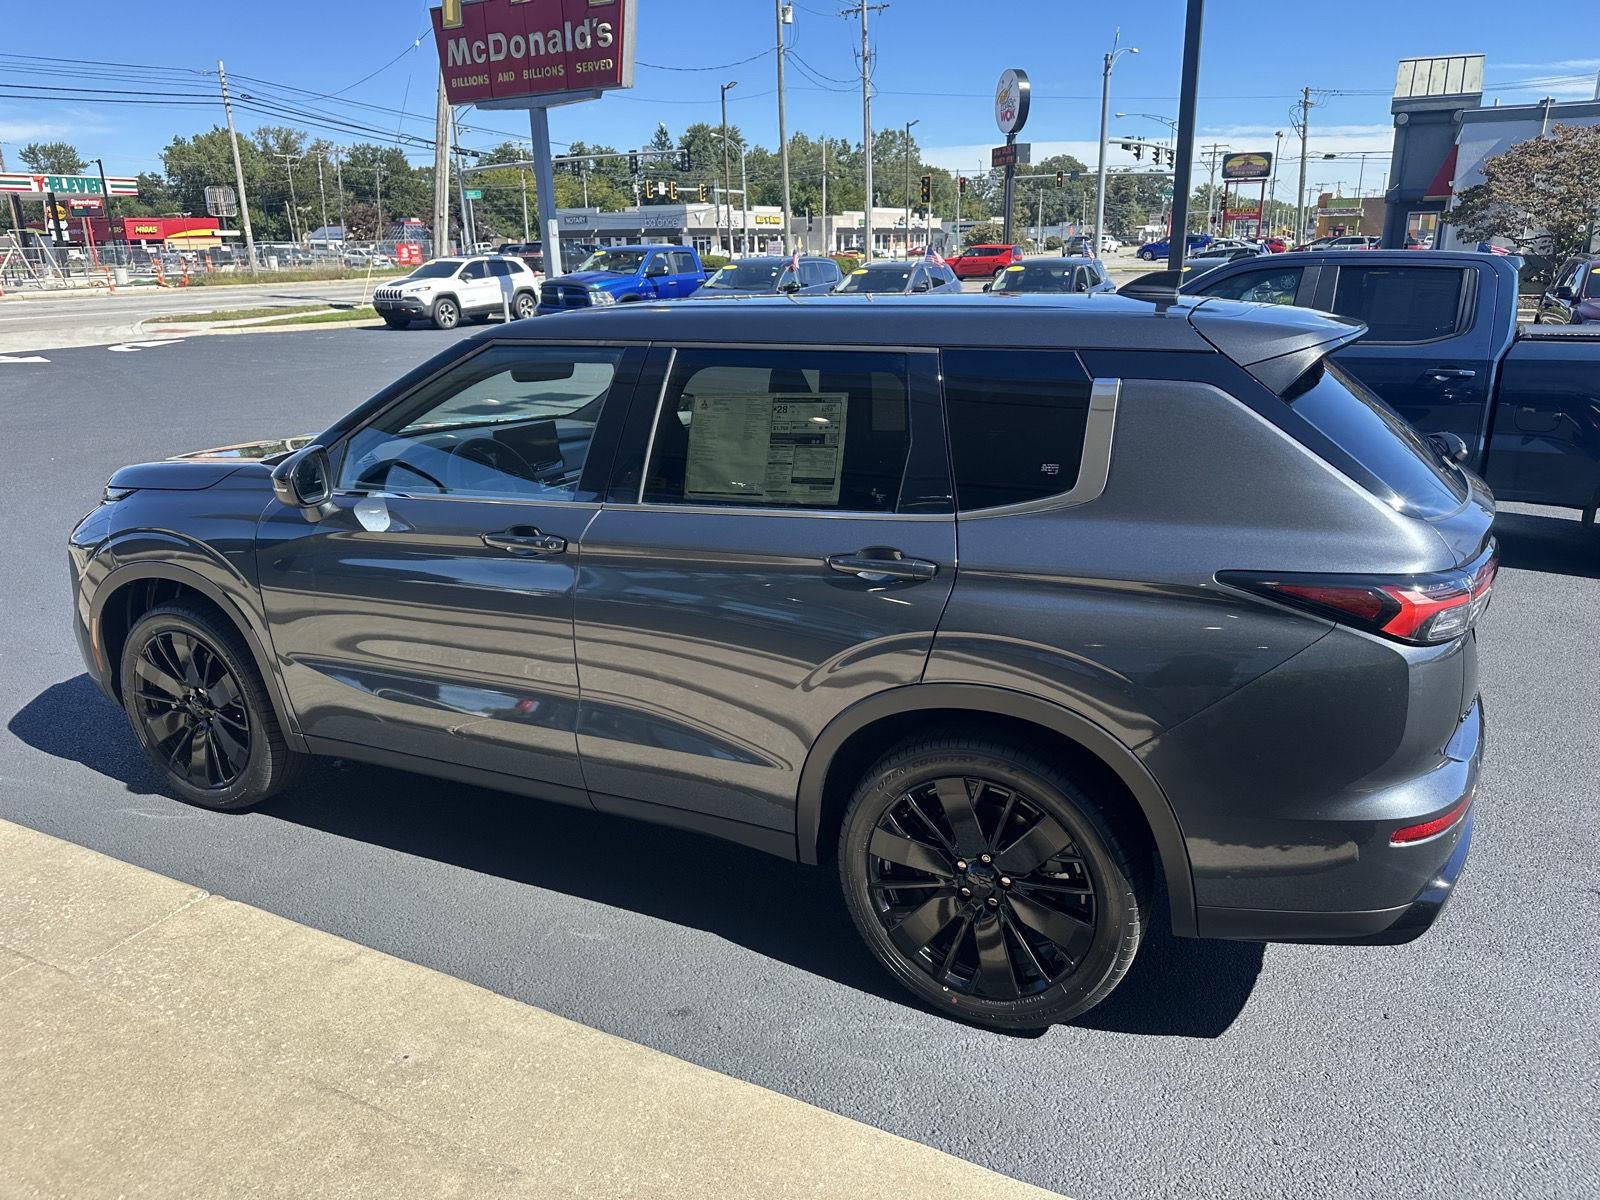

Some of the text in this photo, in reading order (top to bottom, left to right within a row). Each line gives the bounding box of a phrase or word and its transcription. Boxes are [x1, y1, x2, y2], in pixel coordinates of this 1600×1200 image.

[447, 17, 613, 67] McDonald's
[451, 58, 613, 88] BILLIONS AND BILLIONS SERVED
[70, 198, 101, 206] Speedway
[565, 216, 586, 225] NOTARY
